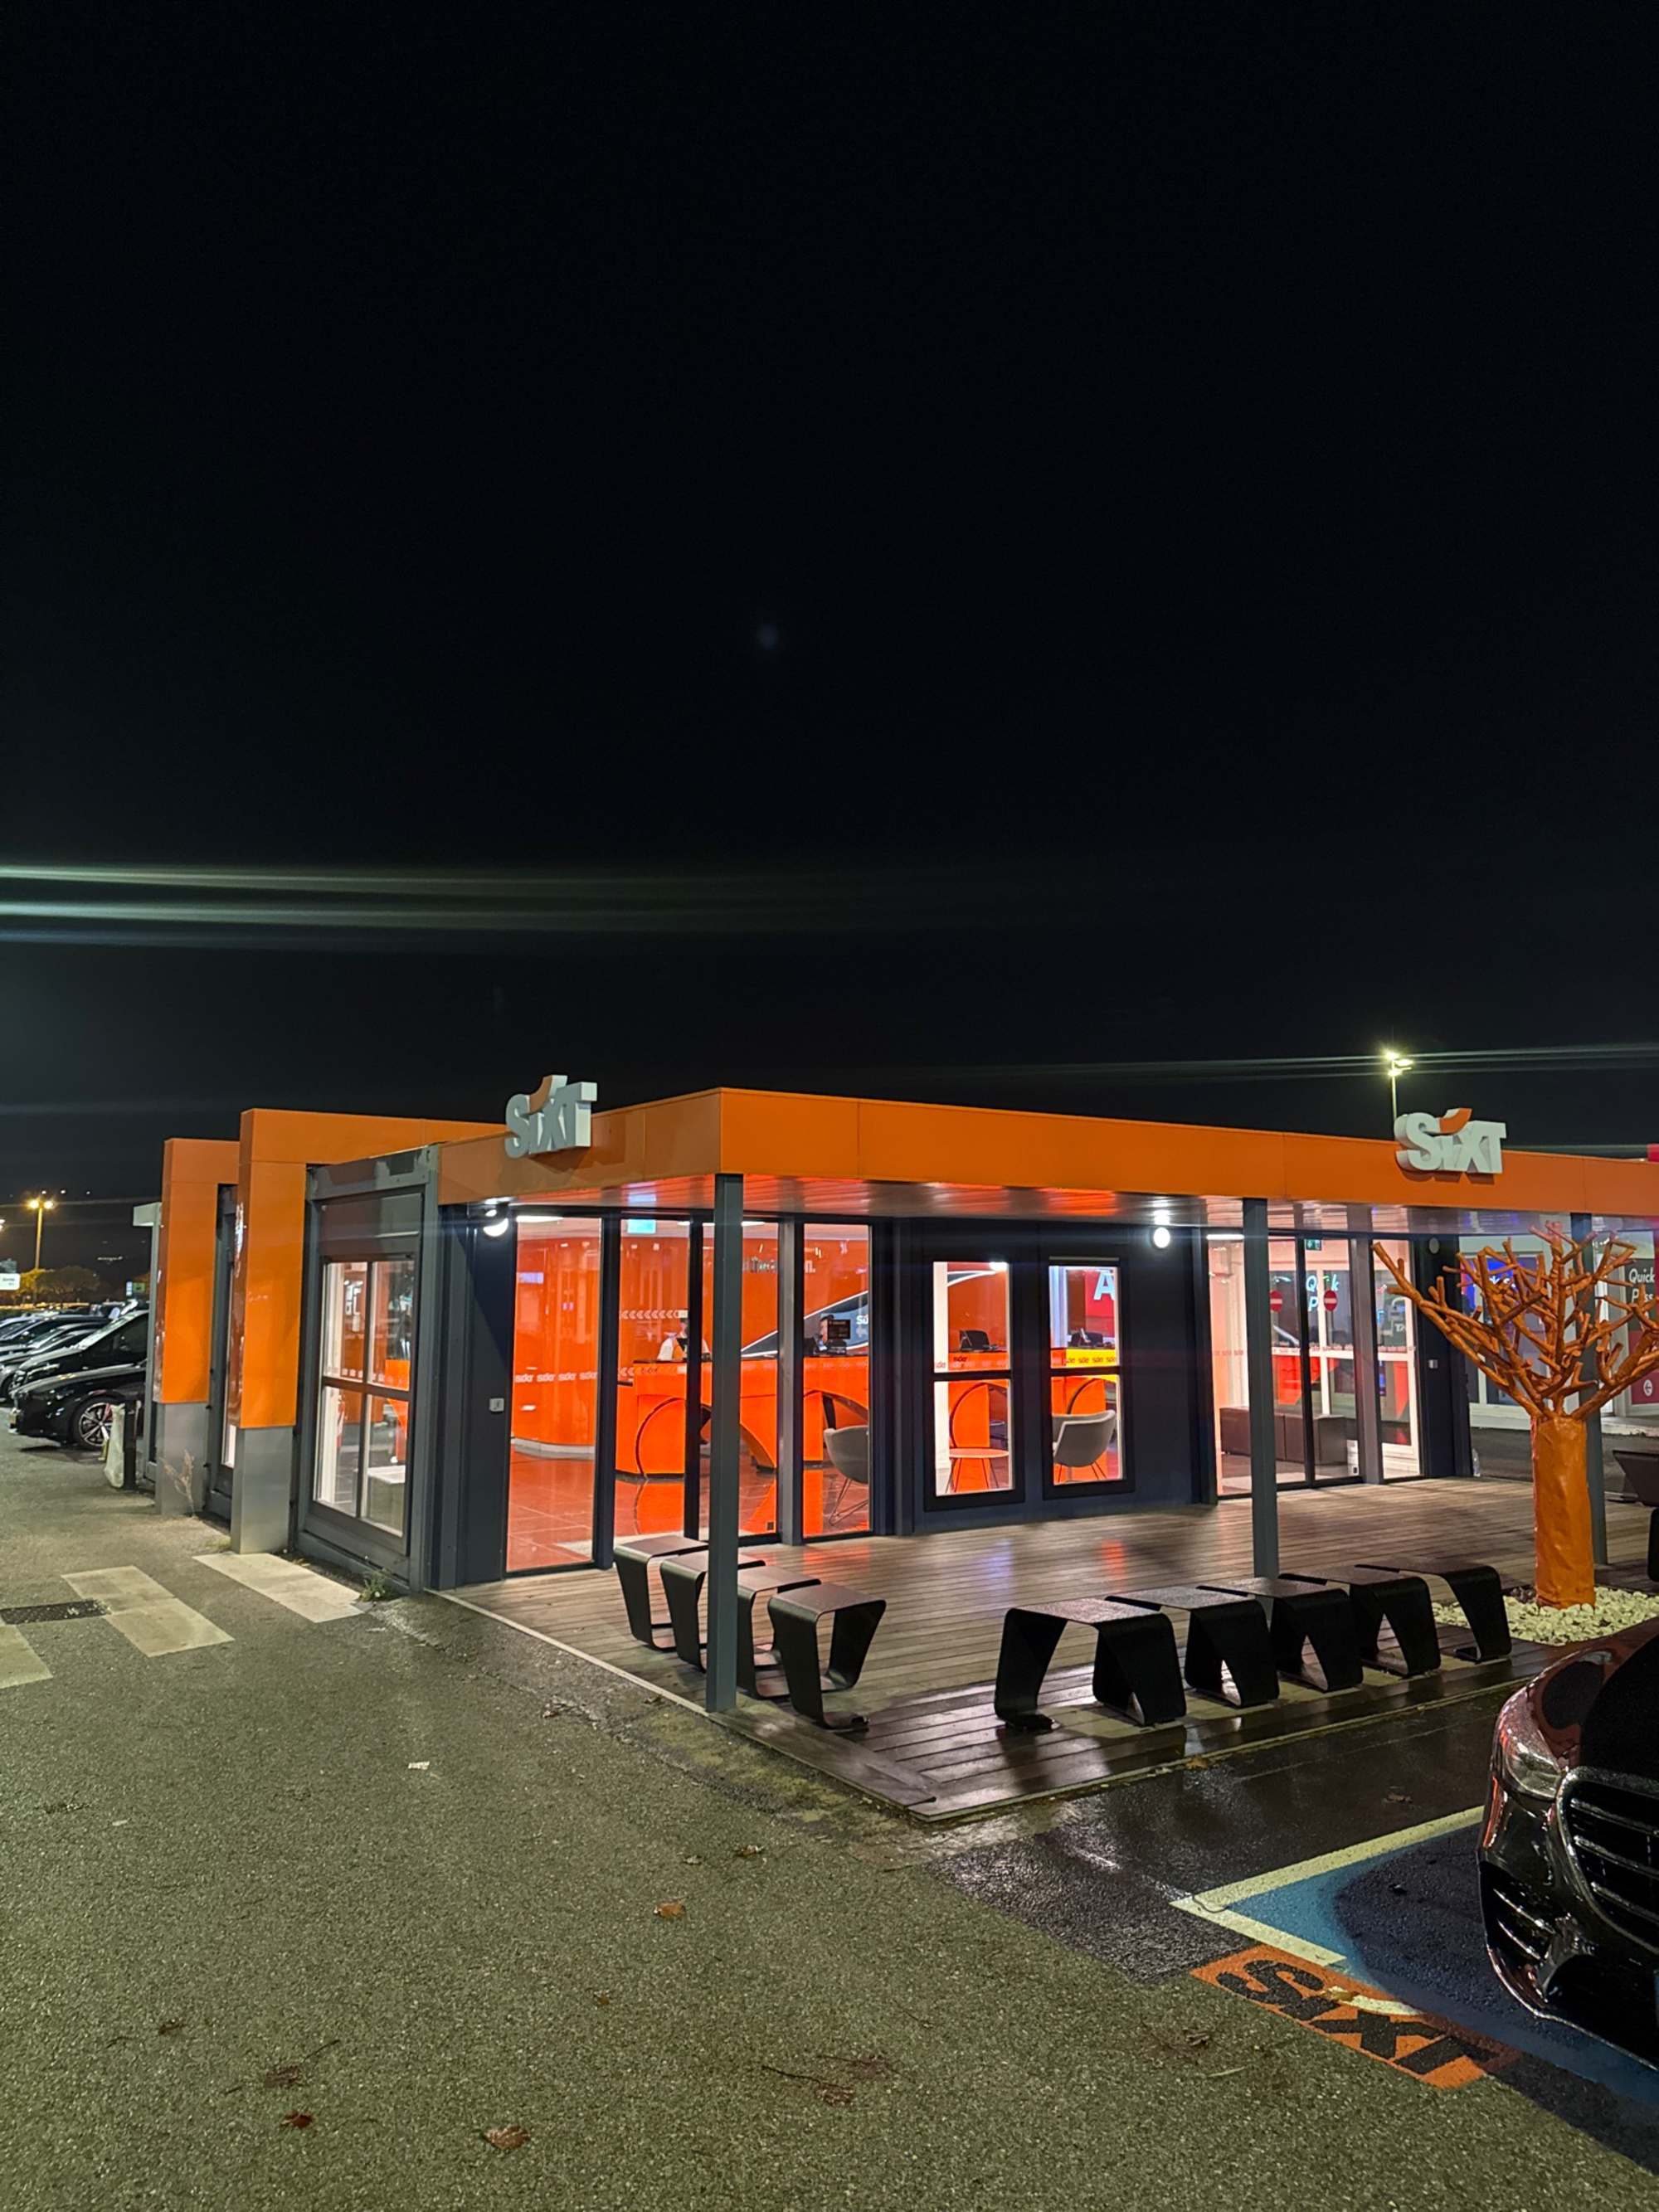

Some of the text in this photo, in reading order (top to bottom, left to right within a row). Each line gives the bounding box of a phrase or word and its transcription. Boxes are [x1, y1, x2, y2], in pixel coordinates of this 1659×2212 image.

[504, 1074, 598, 1159] SIXT
[1394, 1107, 1506, 1174] SIXT
[1628, 1266, 1656, 1284] Quick
[1216, 1957, 1501, 2075] SIXT
